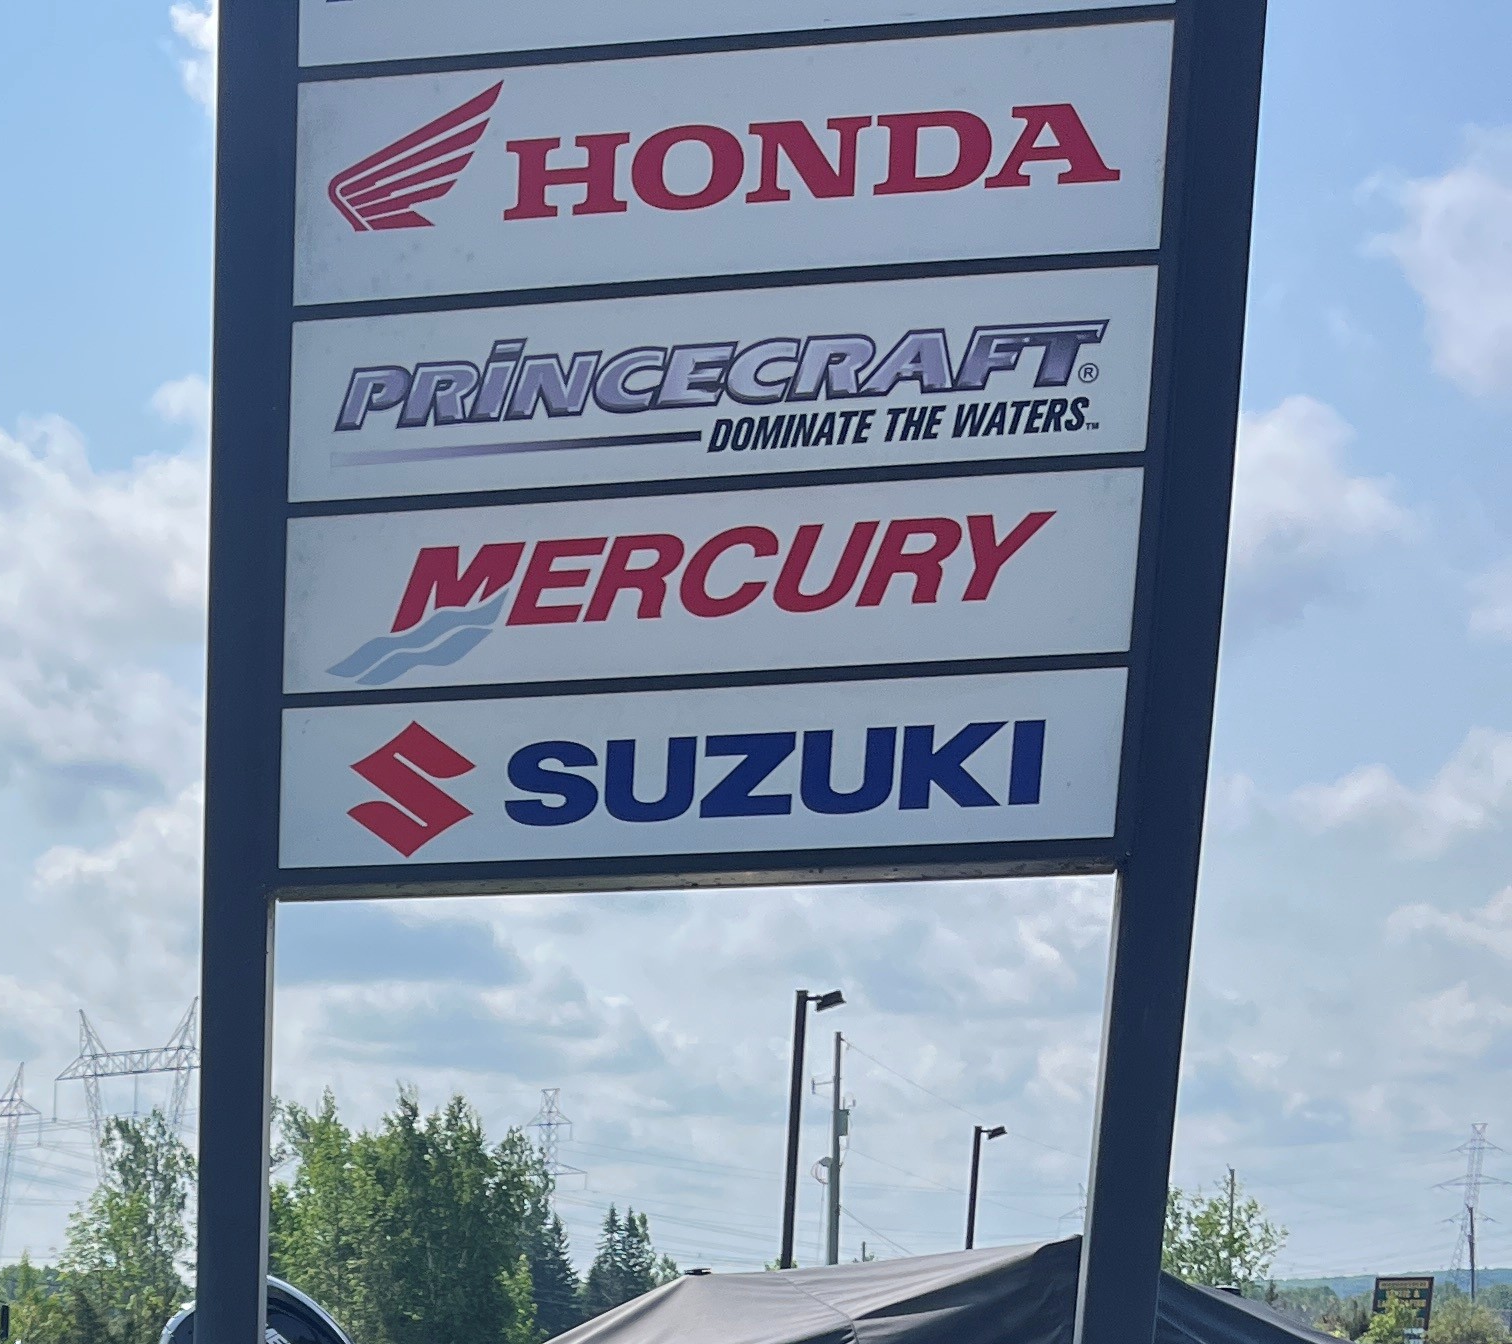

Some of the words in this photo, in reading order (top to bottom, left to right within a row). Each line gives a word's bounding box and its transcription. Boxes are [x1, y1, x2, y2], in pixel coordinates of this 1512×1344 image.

[503, 103, 1121, 221] HONDA
[706, 409, 877, 453] DOMINATE
[885, 404, 947, 442] THE
[390, 510, 1057, 633] MERCURY
[504, 719, 1047, 827] SUZUKI
